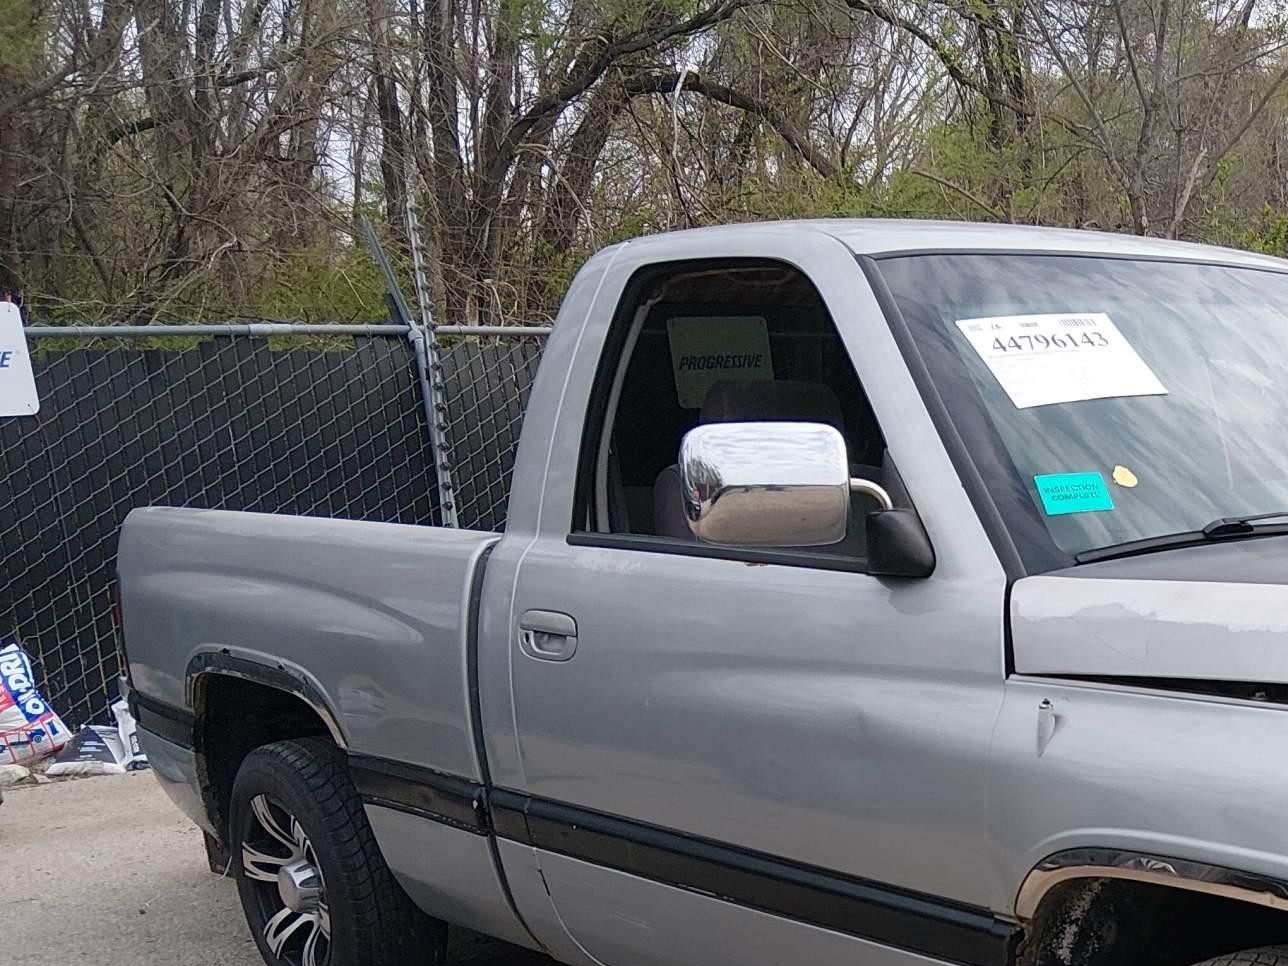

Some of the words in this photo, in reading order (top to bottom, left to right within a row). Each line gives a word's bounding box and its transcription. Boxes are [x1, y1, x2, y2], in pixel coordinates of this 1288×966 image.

[992, 331, 1109, 353] 44796143
[679, 353, 763, 371] PROGRESSIVE
[1043, 483, 1099, 494] INSPECTION
[1051, 492, 1100, 502] COMPLETE
